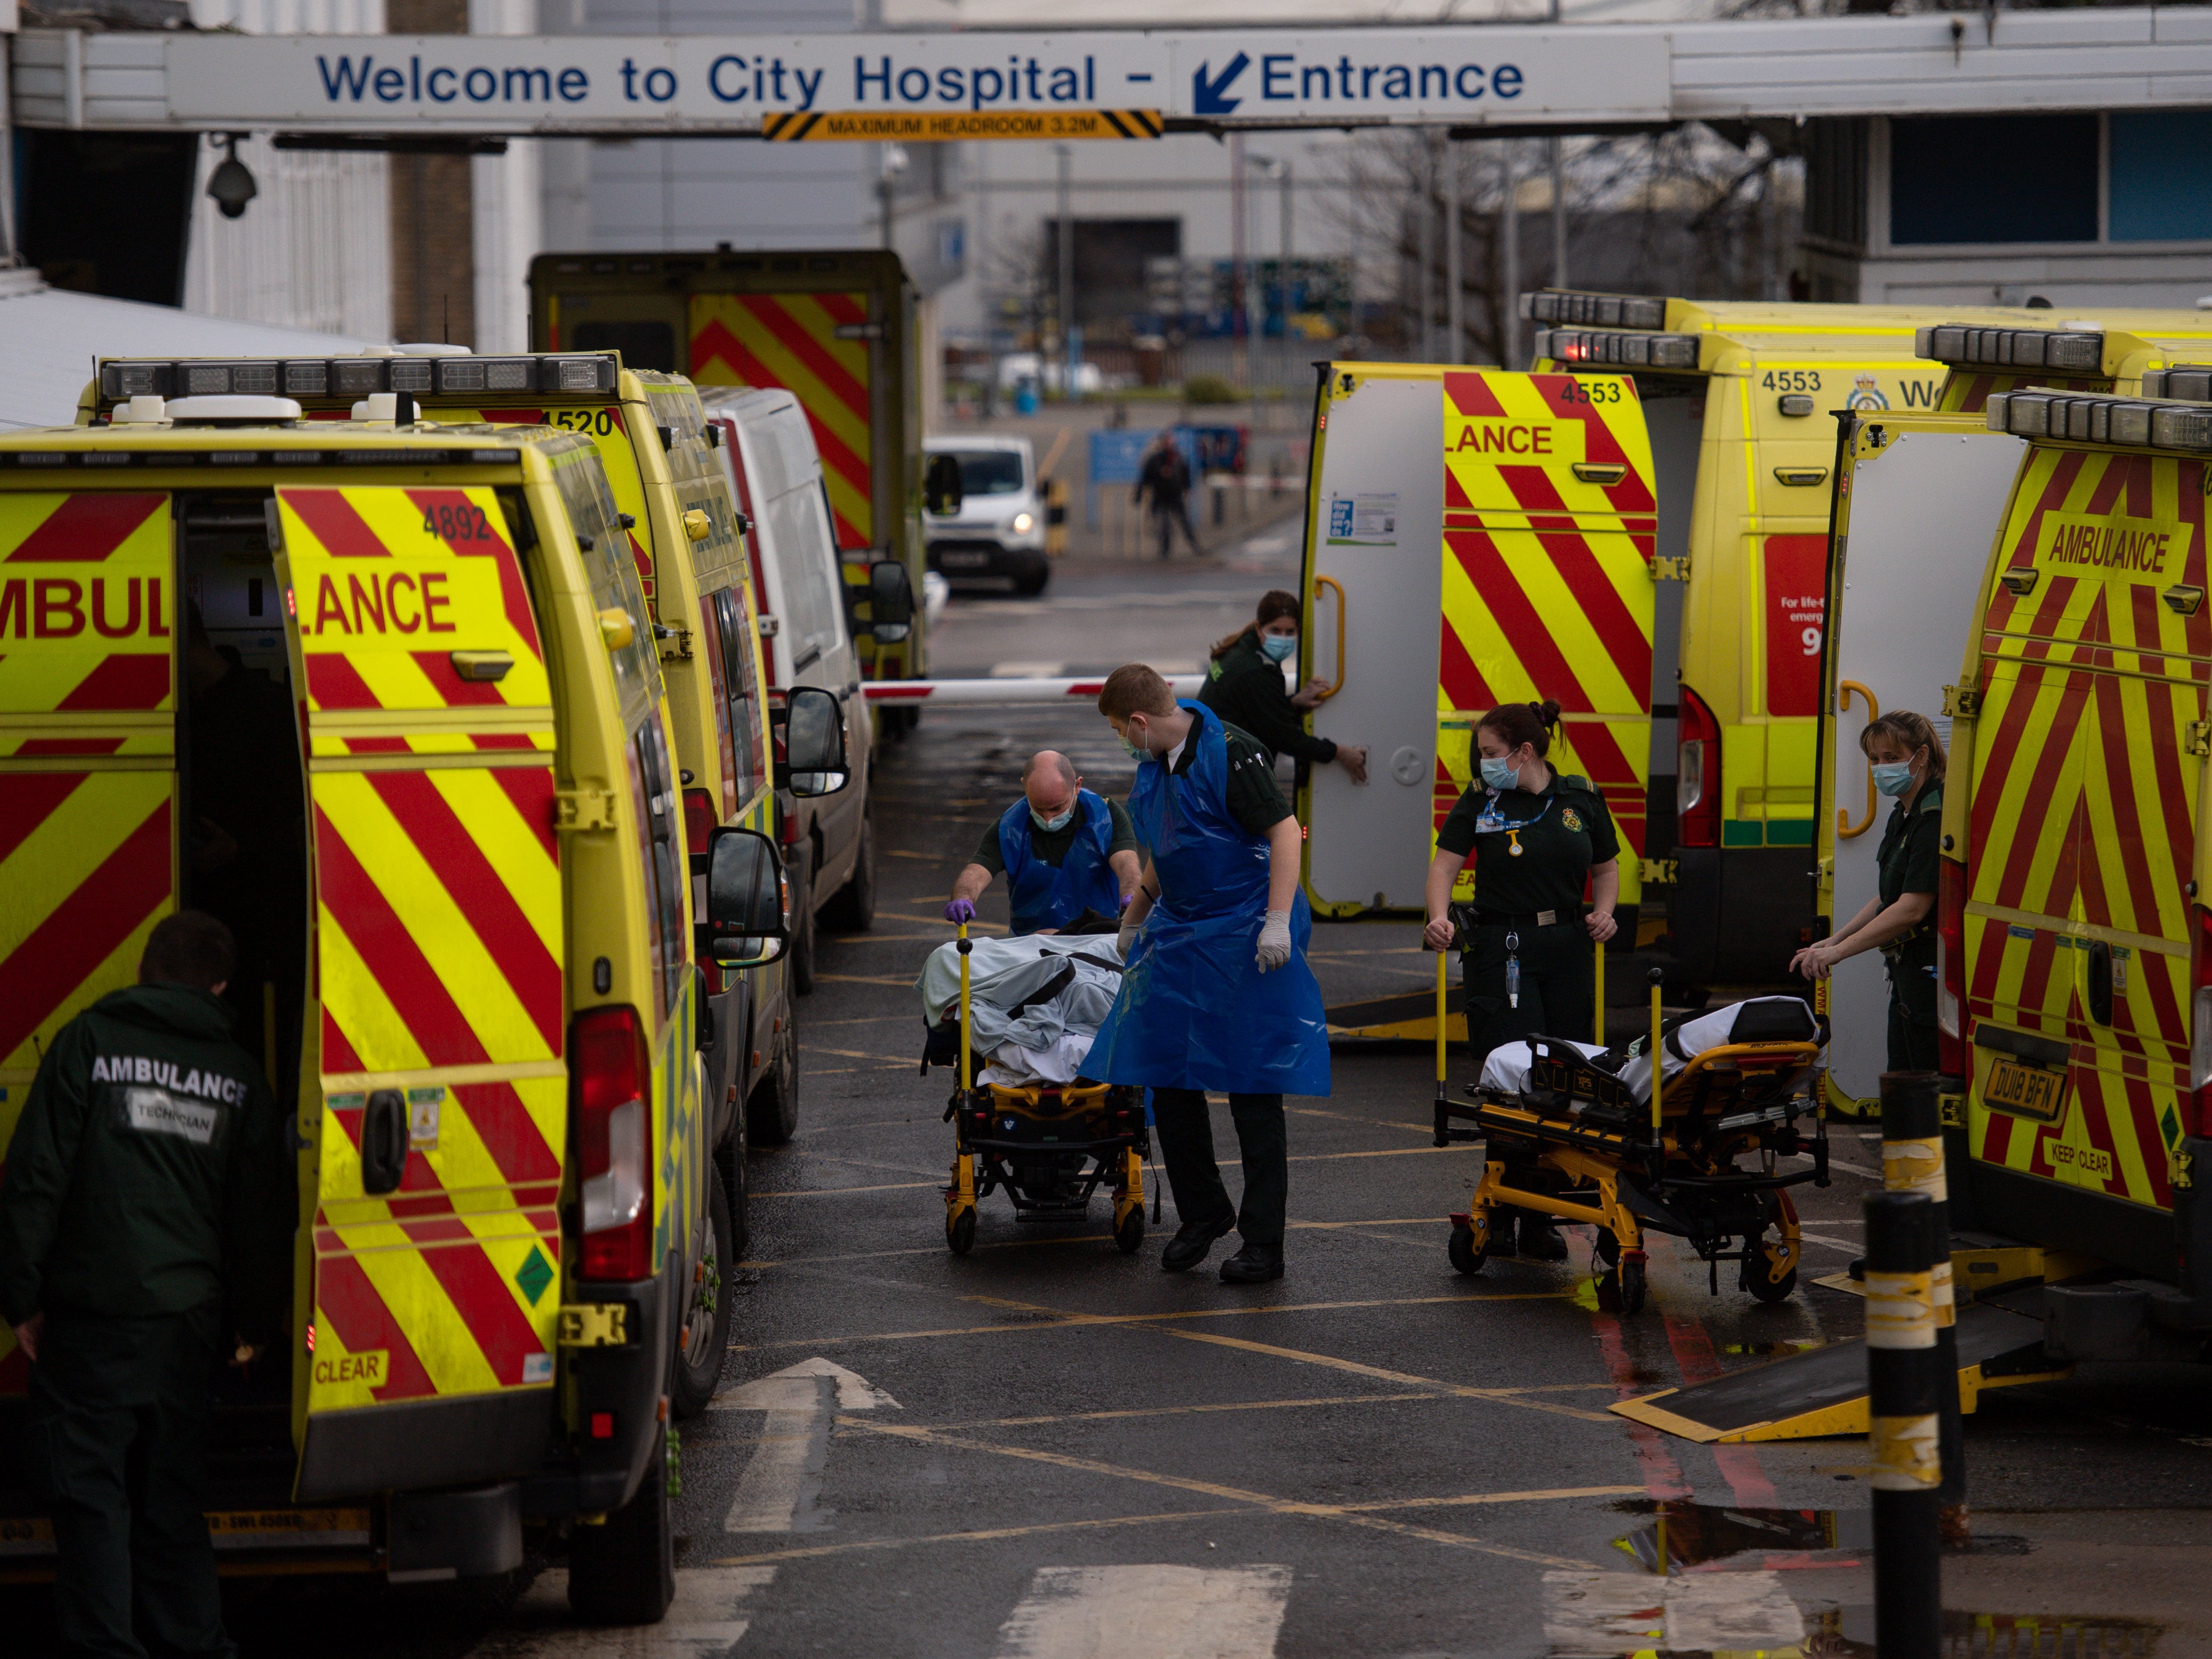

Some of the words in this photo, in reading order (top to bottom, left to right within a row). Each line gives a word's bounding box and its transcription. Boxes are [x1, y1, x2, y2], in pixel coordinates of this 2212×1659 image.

[316, 55, 589, 103] Welcome
[619, 59, 678, 103] to
[707, 55, 824, 111] City
[854, 55, 1095, 111] Hospital
[1261, 53, 1523, 100] Entrance
[827, 117, 922, 136] MAXIMUM
[933, 117, 1042, 134] HEADROOM
[1051, 116, 1097, 133] 3.2M
[1561, 382, 1620, 404] 4553
[1763, 372, 1821, 391] 4553
[1899, 379, 1940, 407] W
[538, 409, 613, 437] 4520
[422, 505, 490, 541] 4892
[2049, 524, 2170, 574] AMBULANCE
[1781, 597, 1798, 608] For
[1801, 627, 1823, 656] 9
[91, 1055, 249, 1108] AMBULANCE
[1818, 1074, 1826, 1110] CHER
[1994, 1067, 2026, 1100] DU18
[2024, 1074, 2055, 1108] BFN
[2052, 1143, 2075, 1164] KEEP
[2079, 1150, 2109, 1174] CLEAR
[315, 1358, 379, 1385] CLEAR
